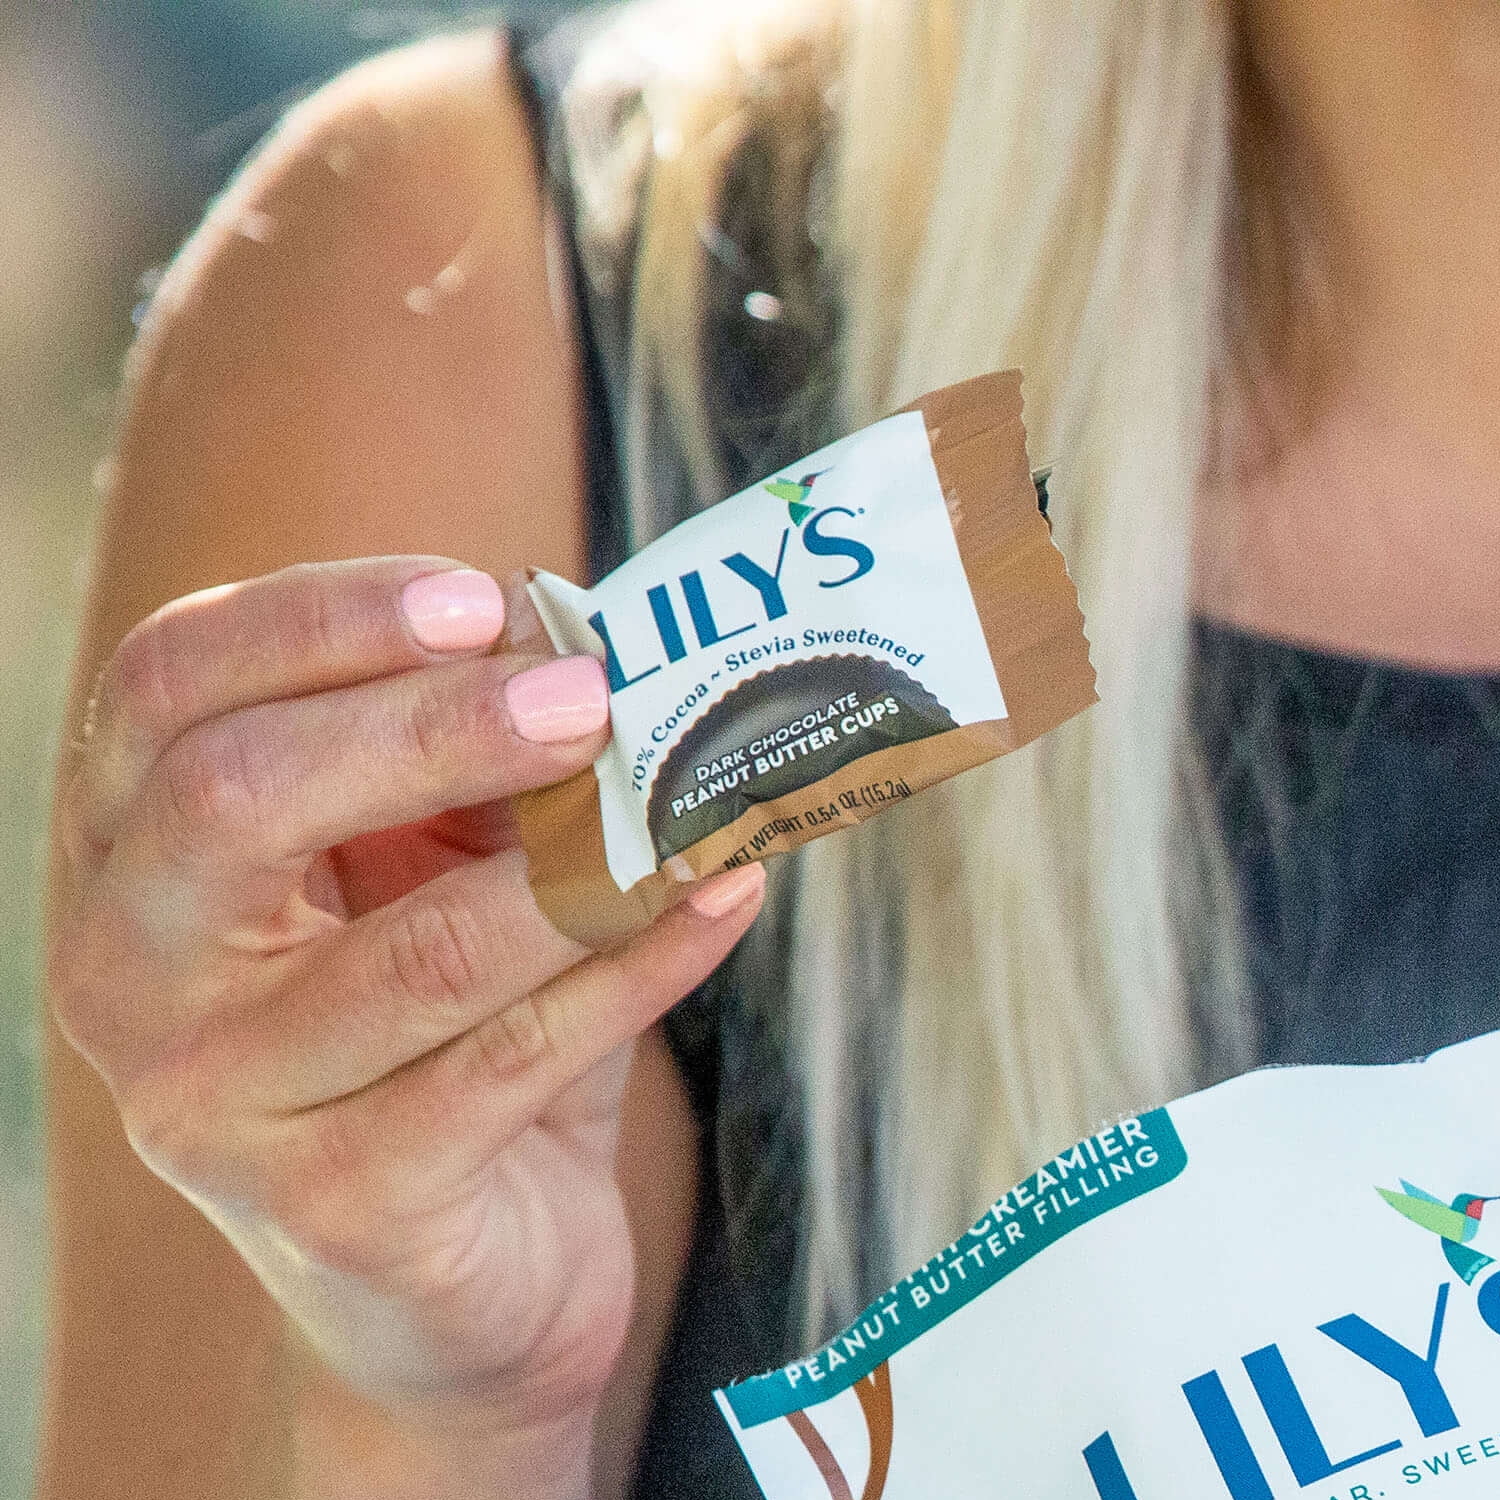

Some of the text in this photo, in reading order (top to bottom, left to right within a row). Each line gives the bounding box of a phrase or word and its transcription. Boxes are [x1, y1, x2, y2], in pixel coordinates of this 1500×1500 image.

[632, 746, 655, 792] 70%
[652, 682, 709, 743] Cocoa
[725, 636, 795, 672] Stevia
[803, 628, 925, 667] Sweetened
[671, 697, 900, 818] PEANUT BUTTER CUPS
[695, 692, 860, 781] DARK CHOCOLATE
[724, 847, 751, 871] NET
[750, 816, 805, 852] WEIGHT
[807, 803, 841, 826] 0.54
[838, 789, 859, 810] OZ
[784, 1303, 901, 1390] PEANUT
[911, 1220, 1025, 1309] BUTTER
[1033, 1145, 1160, 1225] FILLING
